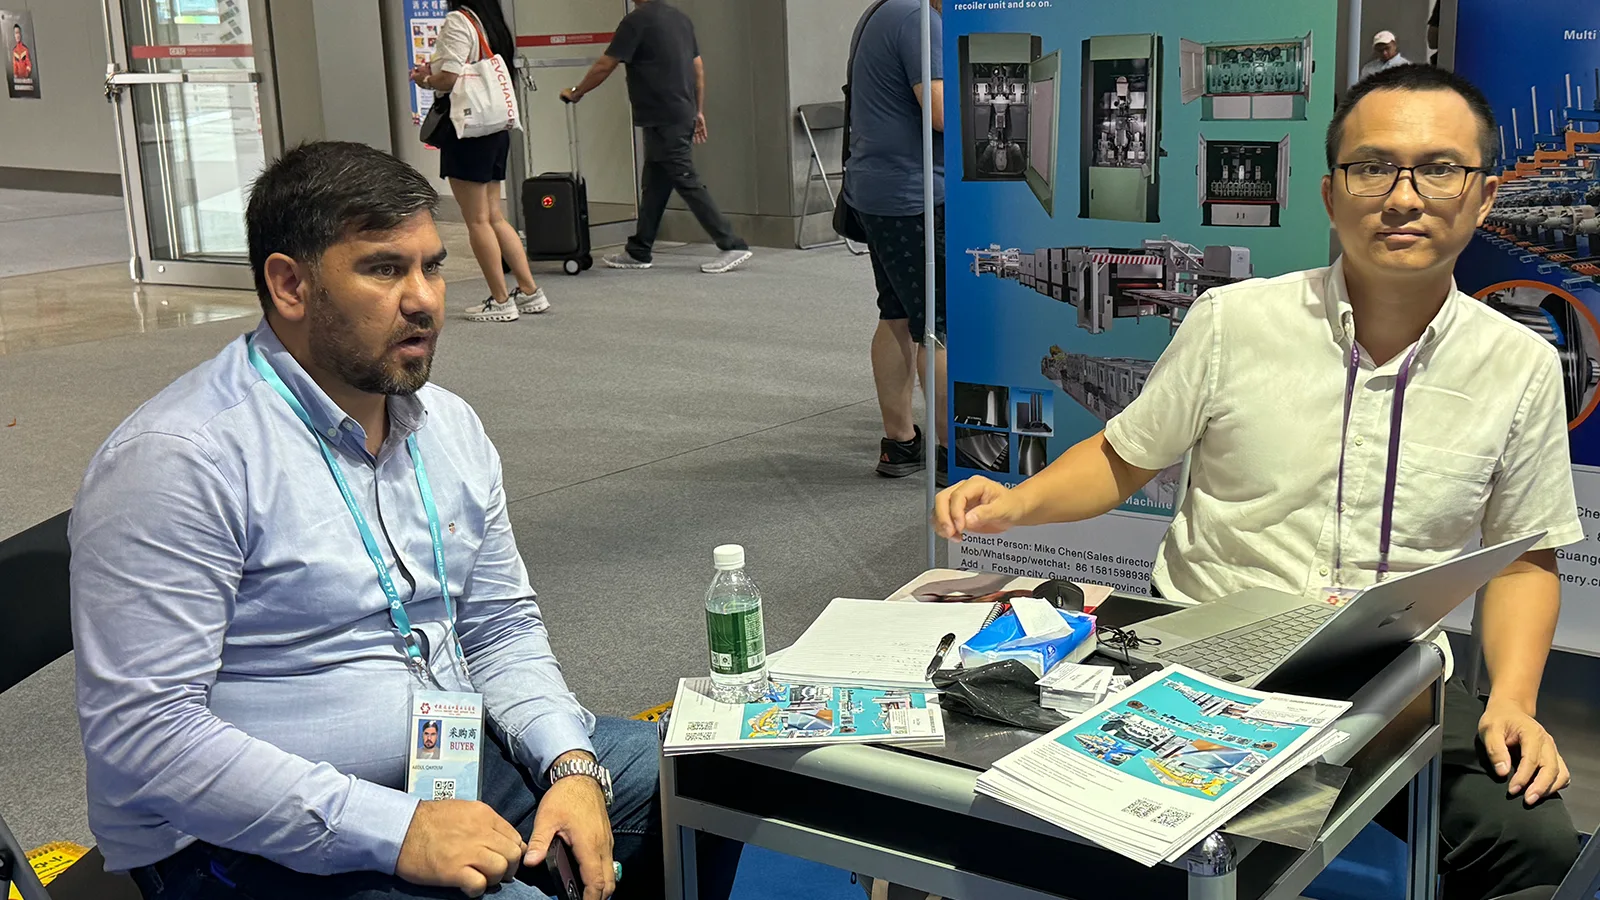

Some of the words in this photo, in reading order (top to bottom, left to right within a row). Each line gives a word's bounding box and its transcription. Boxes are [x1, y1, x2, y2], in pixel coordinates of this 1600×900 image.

[954, 2, 987, 10] recoiler
[988, 1, 1006, 9] unit
[1007, 0, 1024, 9] and
[1038, 0, 1053, 8] on.
[1564, 30, 1597, 40] Multi
[1125, 495, 1173, 510] Machine
[961, 532, 995, 546] Contact
[996, 538, 1032, 551] Person:
[1034, 543, 1056, 555] Mike
[1057, 546, 1114, 563] Chen(Sales
[991, 563, 1025, 576] Foshan
[1075, 562, 1088, 573] 86
[449, 726, 477, 740] 采购商
[450, 742, 475, 751] BUYER
